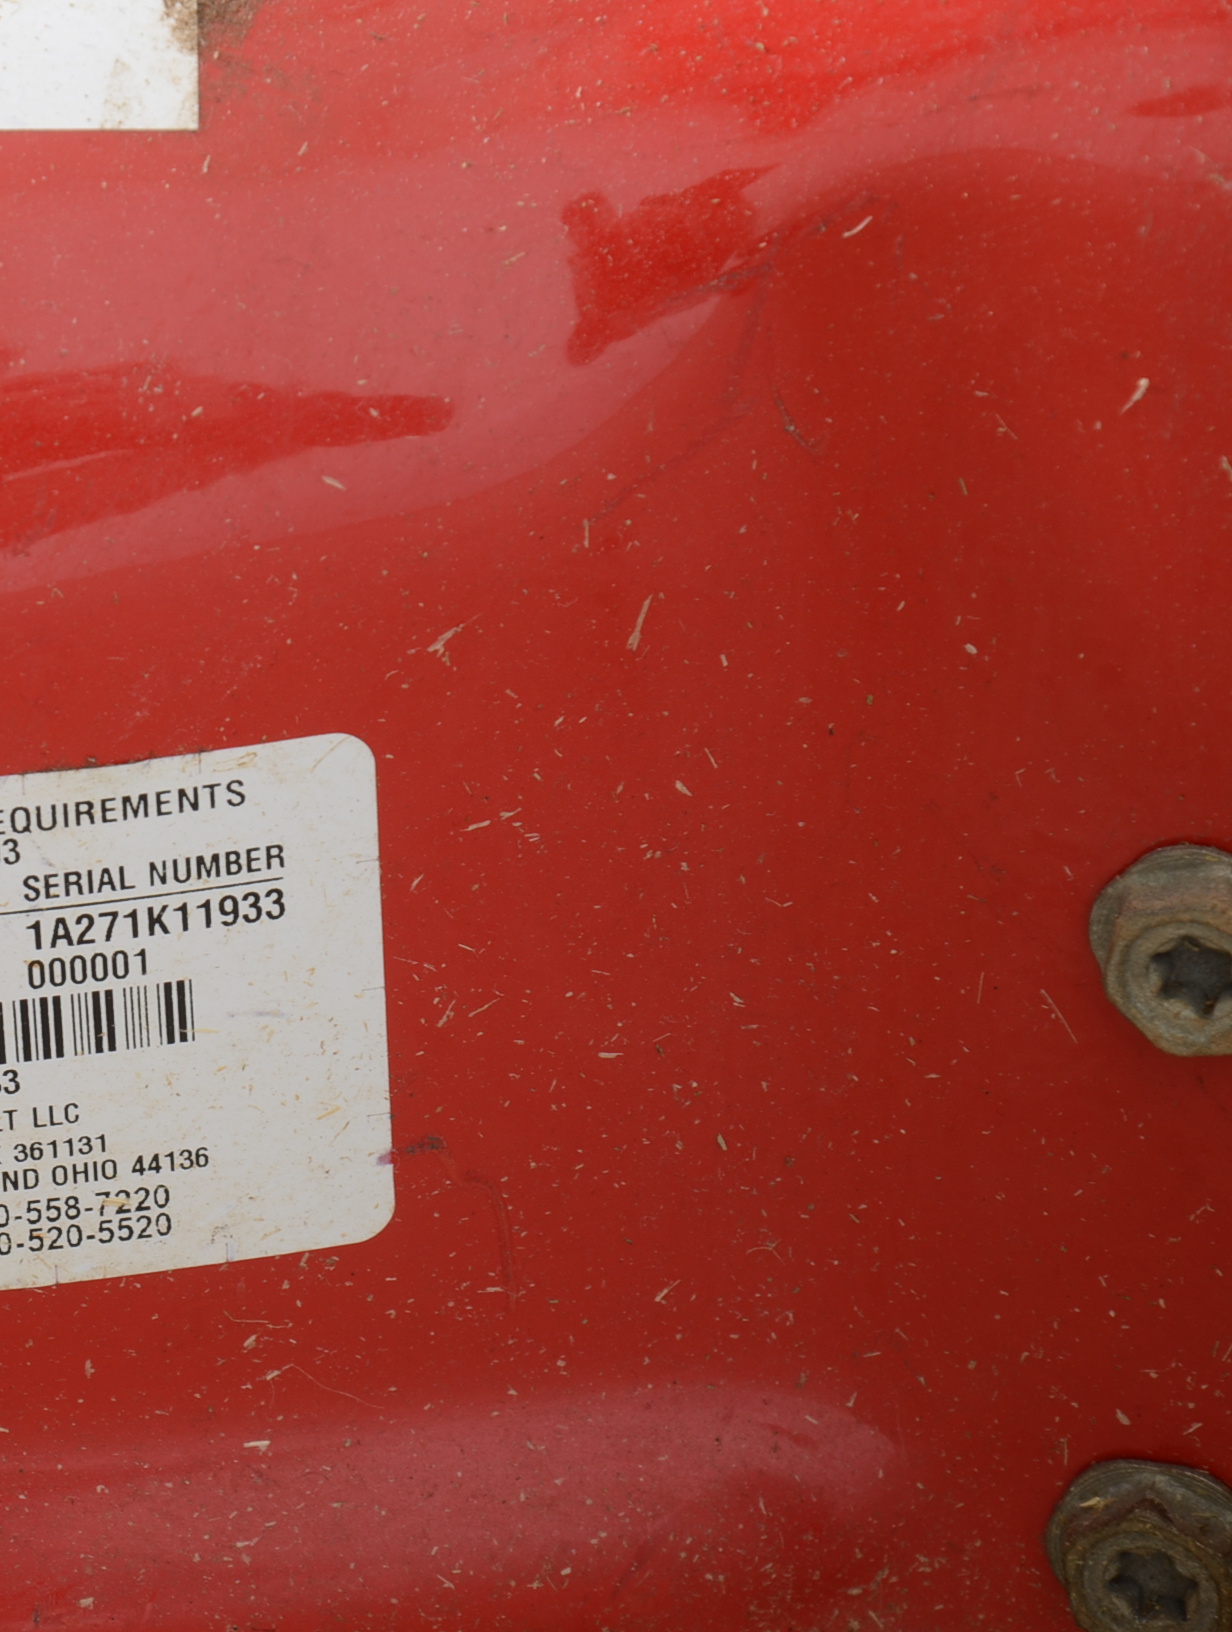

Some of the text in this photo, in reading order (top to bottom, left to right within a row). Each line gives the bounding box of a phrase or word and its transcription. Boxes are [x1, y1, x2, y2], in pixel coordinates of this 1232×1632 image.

[22, 844, 286, 902] SERIAL NUMBER
[26, 888, 286, 950] 1A271K11933
[27, 949, 150, 989] 000001
[32, 1102, 80, 1128] LLC
[13, 1134, 108, 1163] 361131
[51, 1159, 118, 1187] OHIO
[131, 1146, 210, 1177] 44136
